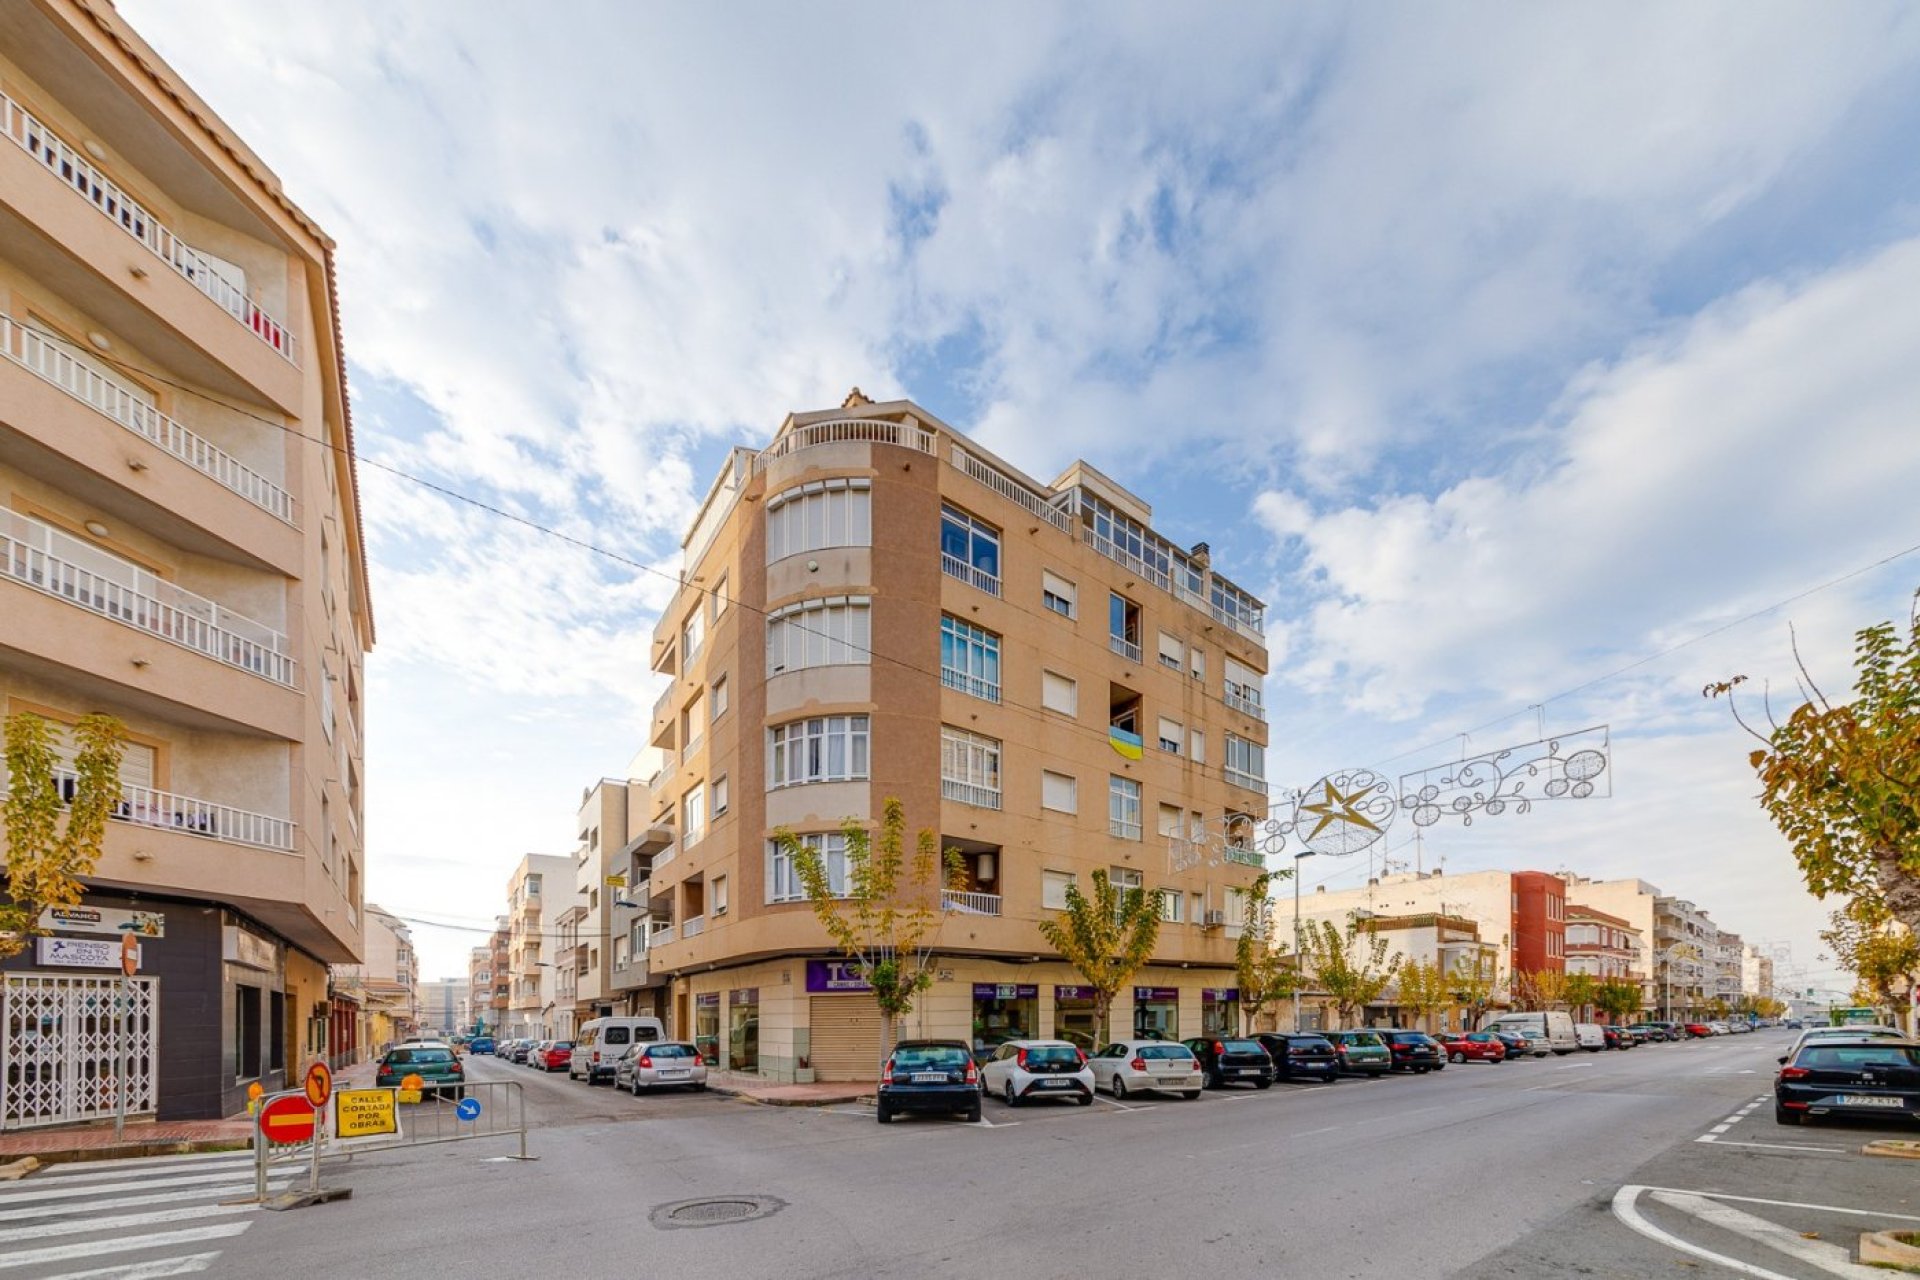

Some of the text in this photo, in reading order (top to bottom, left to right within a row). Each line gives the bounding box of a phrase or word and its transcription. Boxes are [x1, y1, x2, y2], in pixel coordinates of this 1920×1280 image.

[66, 941, 110, 950] PIENSO
[49, 953, 110, 961] MASCOTA
[351, 1096, 383, 1104] CALLE
[342, 1103, 391, 1112] CORTADA
[357, 1112, 380, 1120] POR
[349, 1120, 386, 1129] OBRAS
